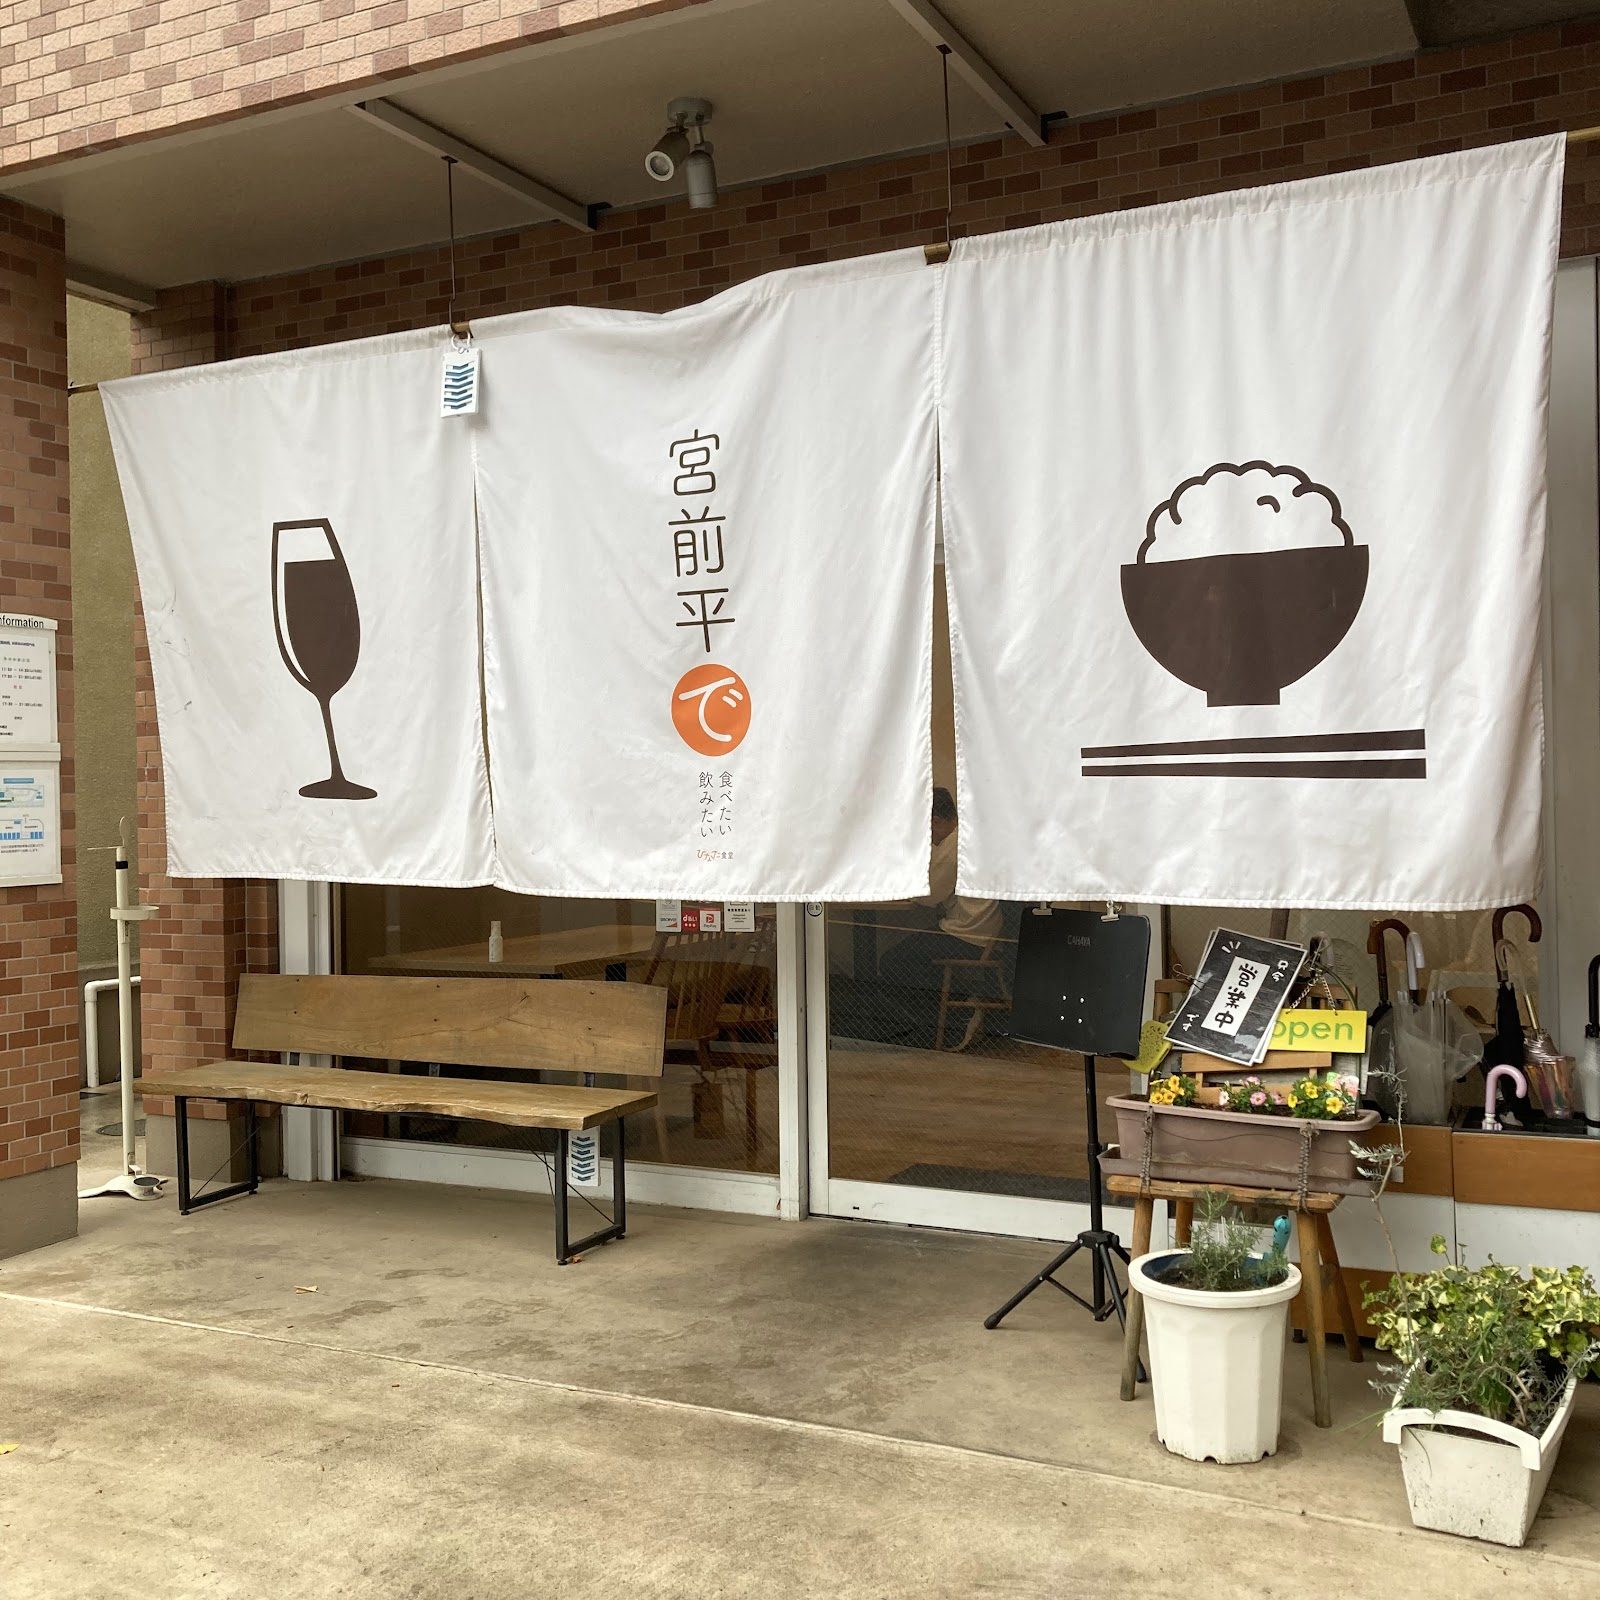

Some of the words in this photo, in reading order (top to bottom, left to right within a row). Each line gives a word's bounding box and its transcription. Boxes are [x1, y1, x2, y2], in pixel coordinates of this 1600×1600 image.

[668, 428, 735, 653] 宮前平
[678, 676, 744, 742] で
[698, 771, 714, 838] 飲みたい
[718, 770, 733, 836] 食べたい
[1214, 962, 1259, 1029] 営業中
[1272, 1018, 1353, 1046] open
